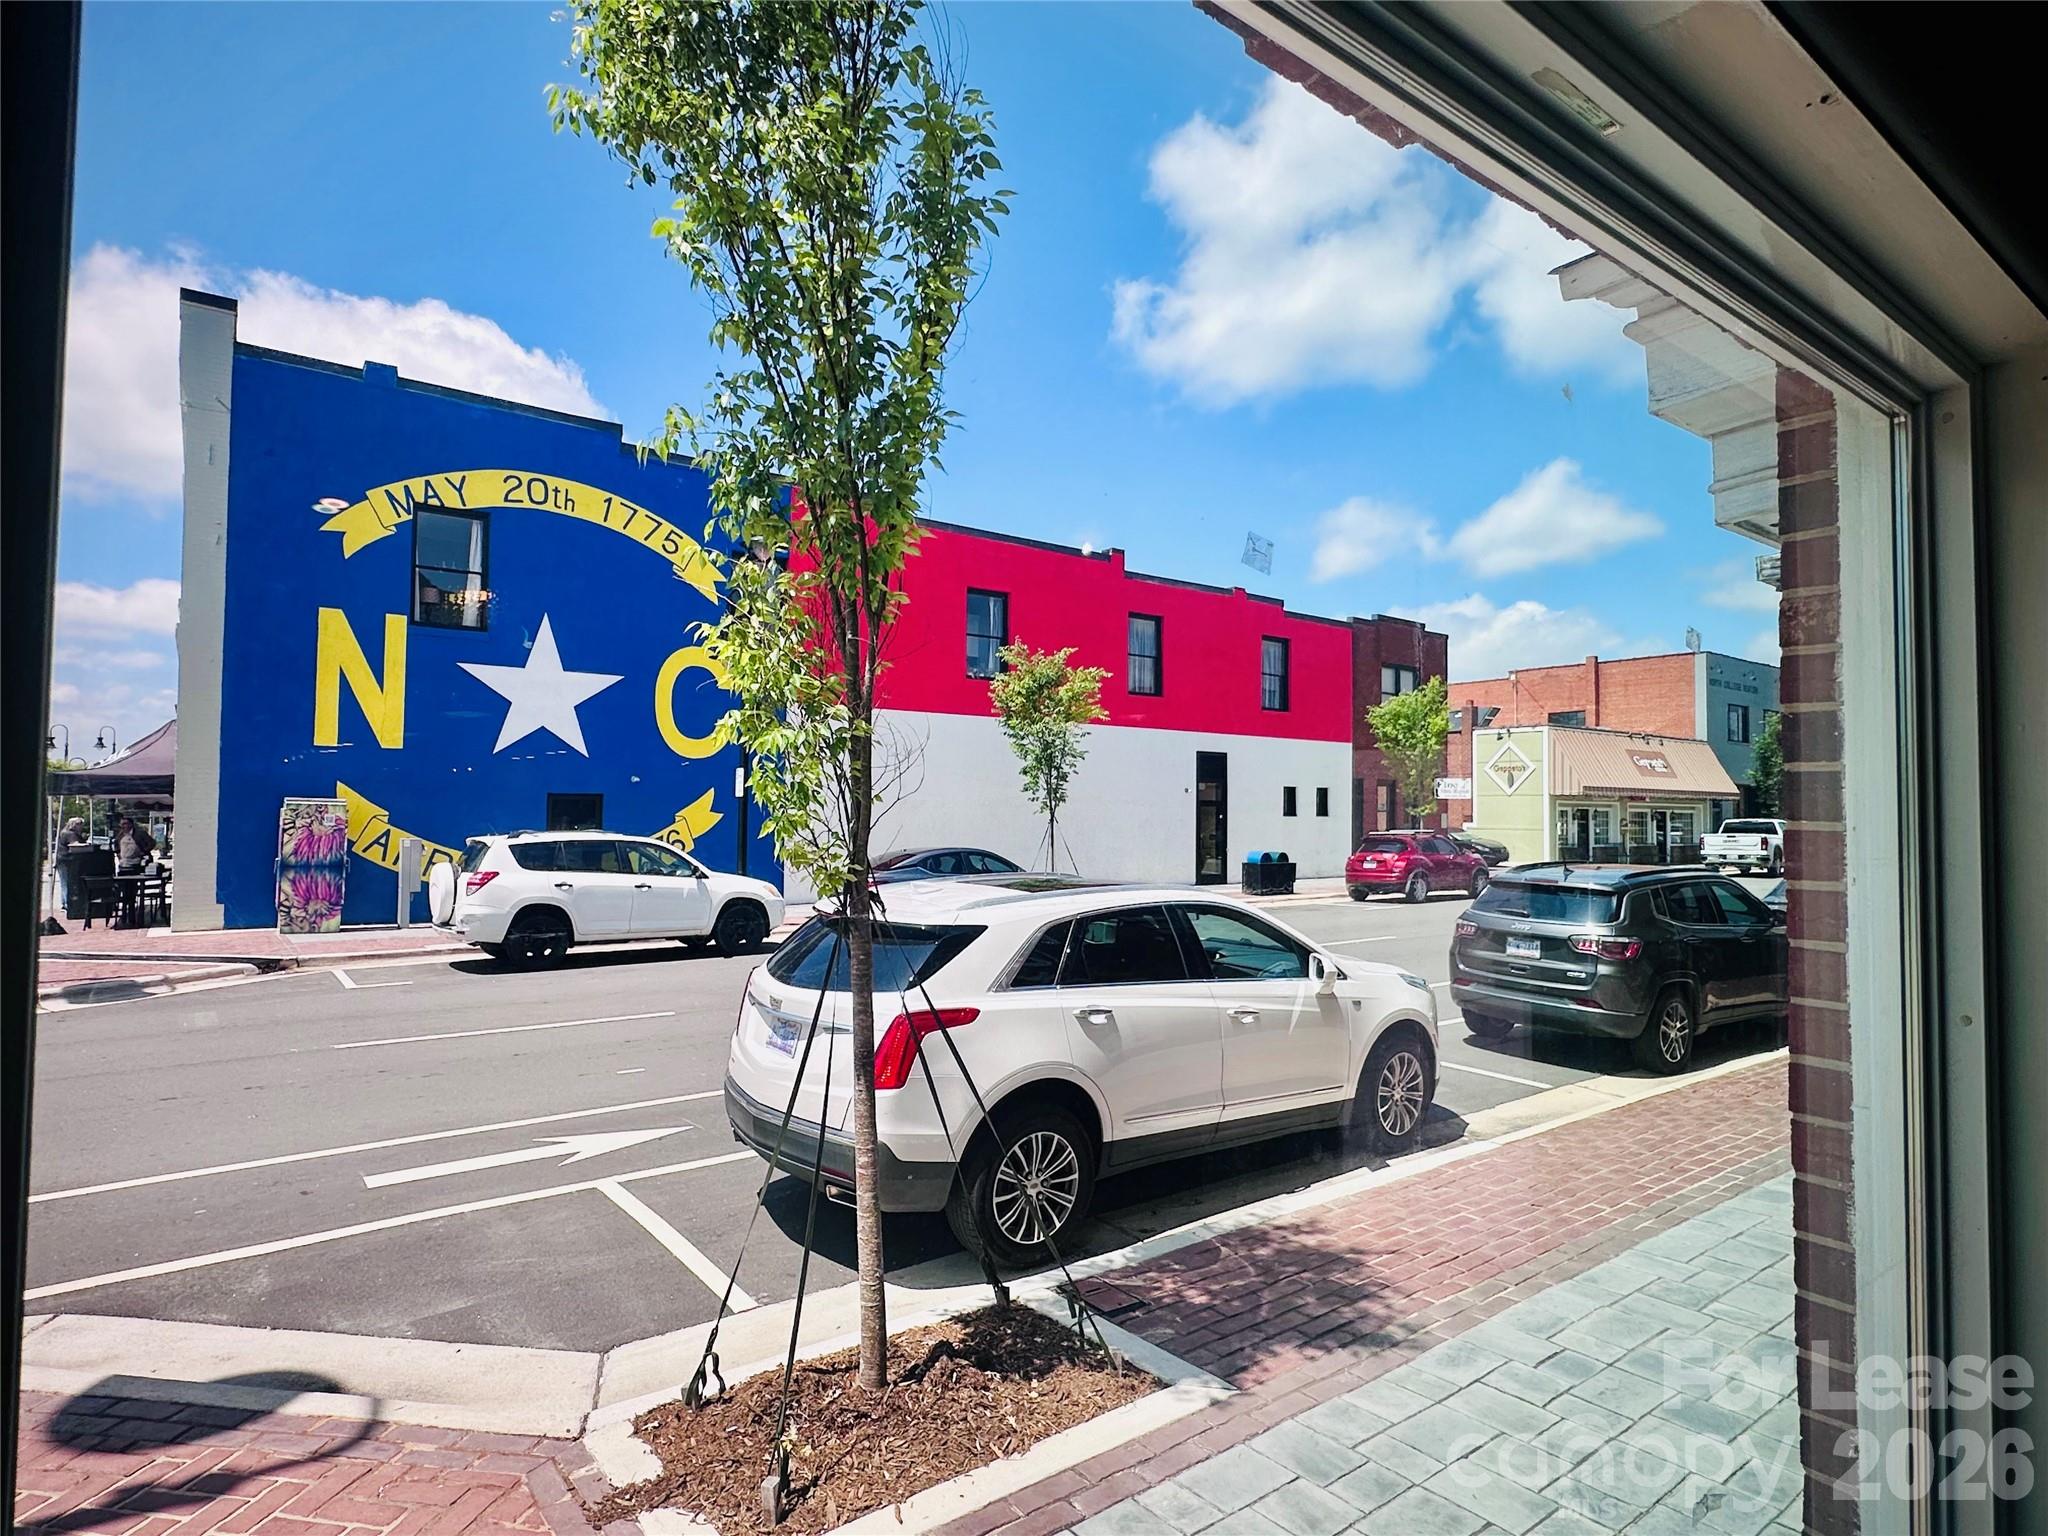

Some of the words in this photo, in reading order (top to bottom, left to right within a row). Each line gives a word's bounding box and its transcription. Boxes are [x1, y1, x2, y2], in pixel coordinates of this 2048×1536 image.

[384, 475, 468, 519] MAY
[502, 474, 576, 513] 20th
[602, 496, 685, 555] 1775
[313, 606, 408, 750] N
[654, 645, 734, 760] C
